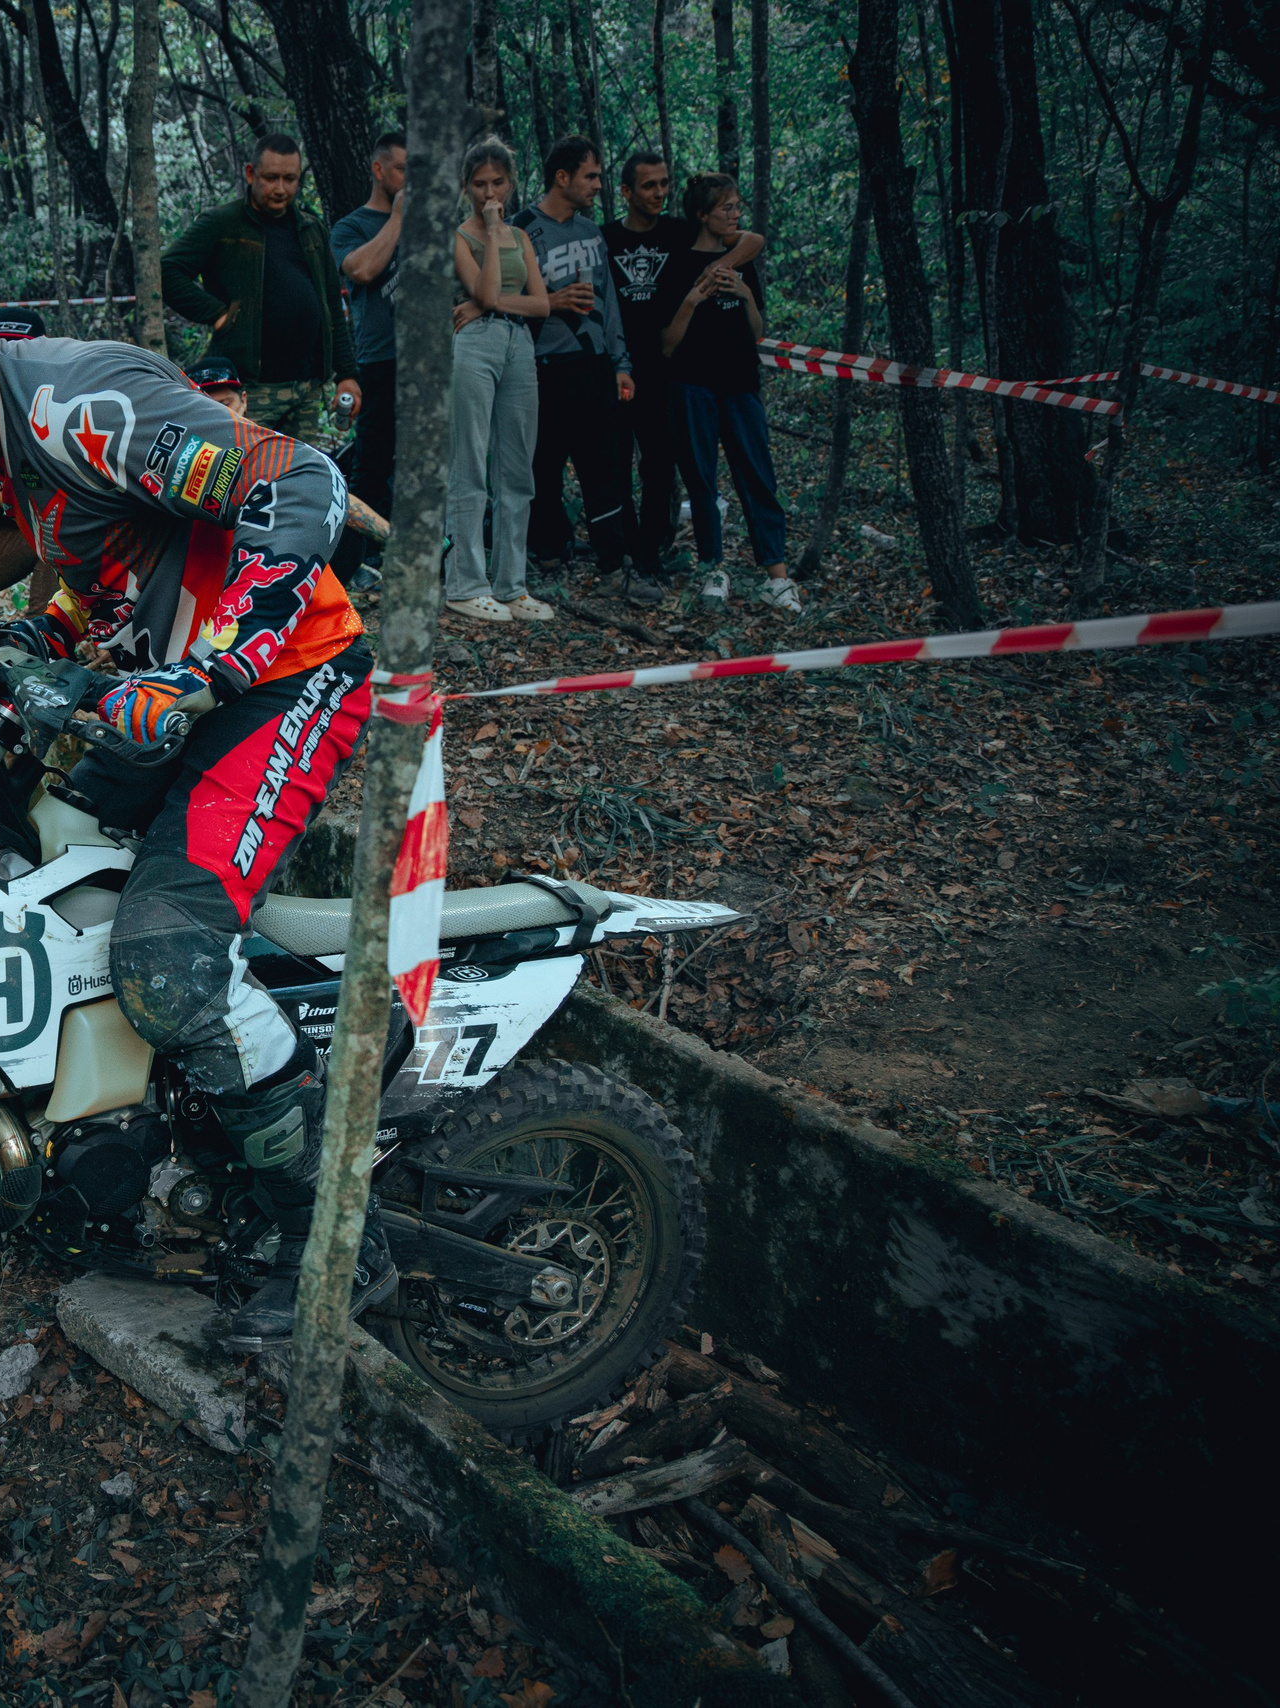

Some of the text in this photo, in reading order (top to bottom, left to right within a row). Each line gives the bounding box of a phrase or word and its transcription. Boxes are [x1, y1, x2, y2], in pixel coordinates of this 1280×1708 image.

[632, 292, 651, 301] 2024
[172, 438, 200, 485] MOTOREX
[185, 448, 214, 500] PIRELLI
[254, 741, 295, 821] TEAM
